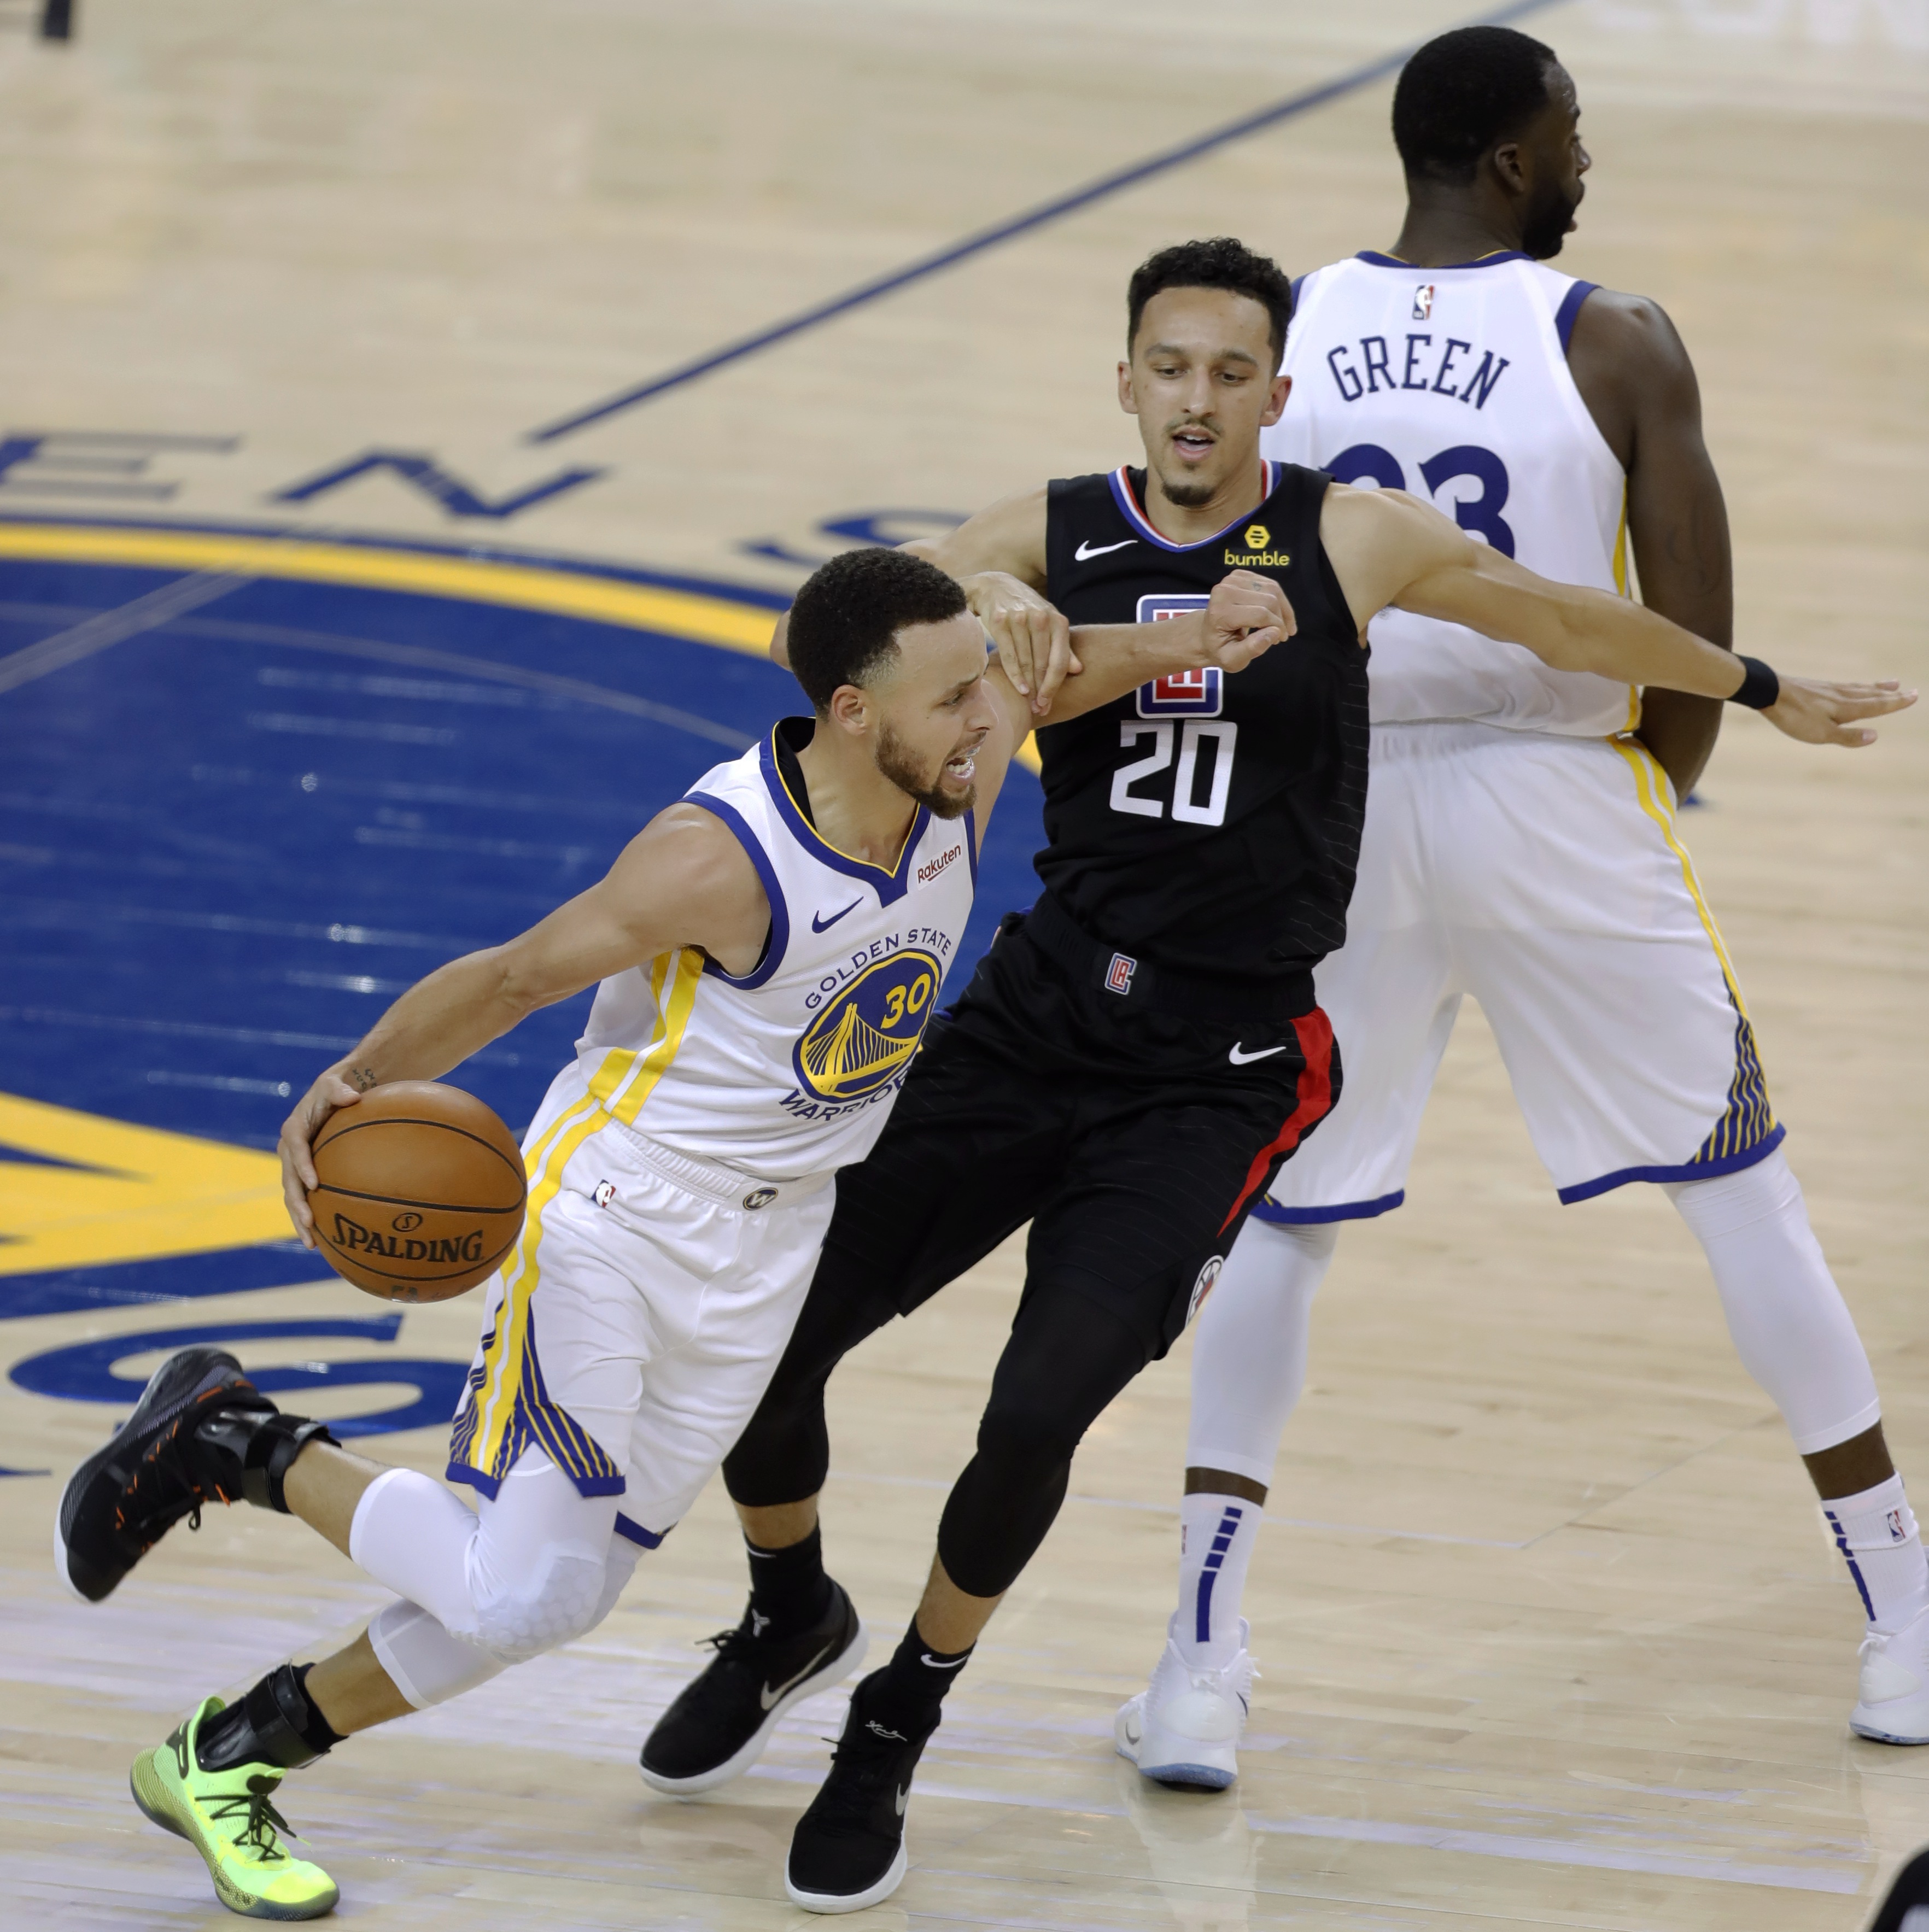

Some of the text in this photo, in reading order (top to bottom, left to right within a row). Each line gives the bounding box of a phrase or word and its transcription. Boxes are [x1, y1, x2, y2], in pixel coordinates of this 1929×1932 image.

[1326, 334, 1510, 409] GREEN
[1224, 548, 1290, 566] bumble
[1109, 719, 1237, 827] 20
[917, 845, 961, 884] Rakuten
[805, 927, 951, 1009] GOLDEN STATE
[880, 973, 931, 1029] 30
[332, 1213, 483, 1263] SPALDING
